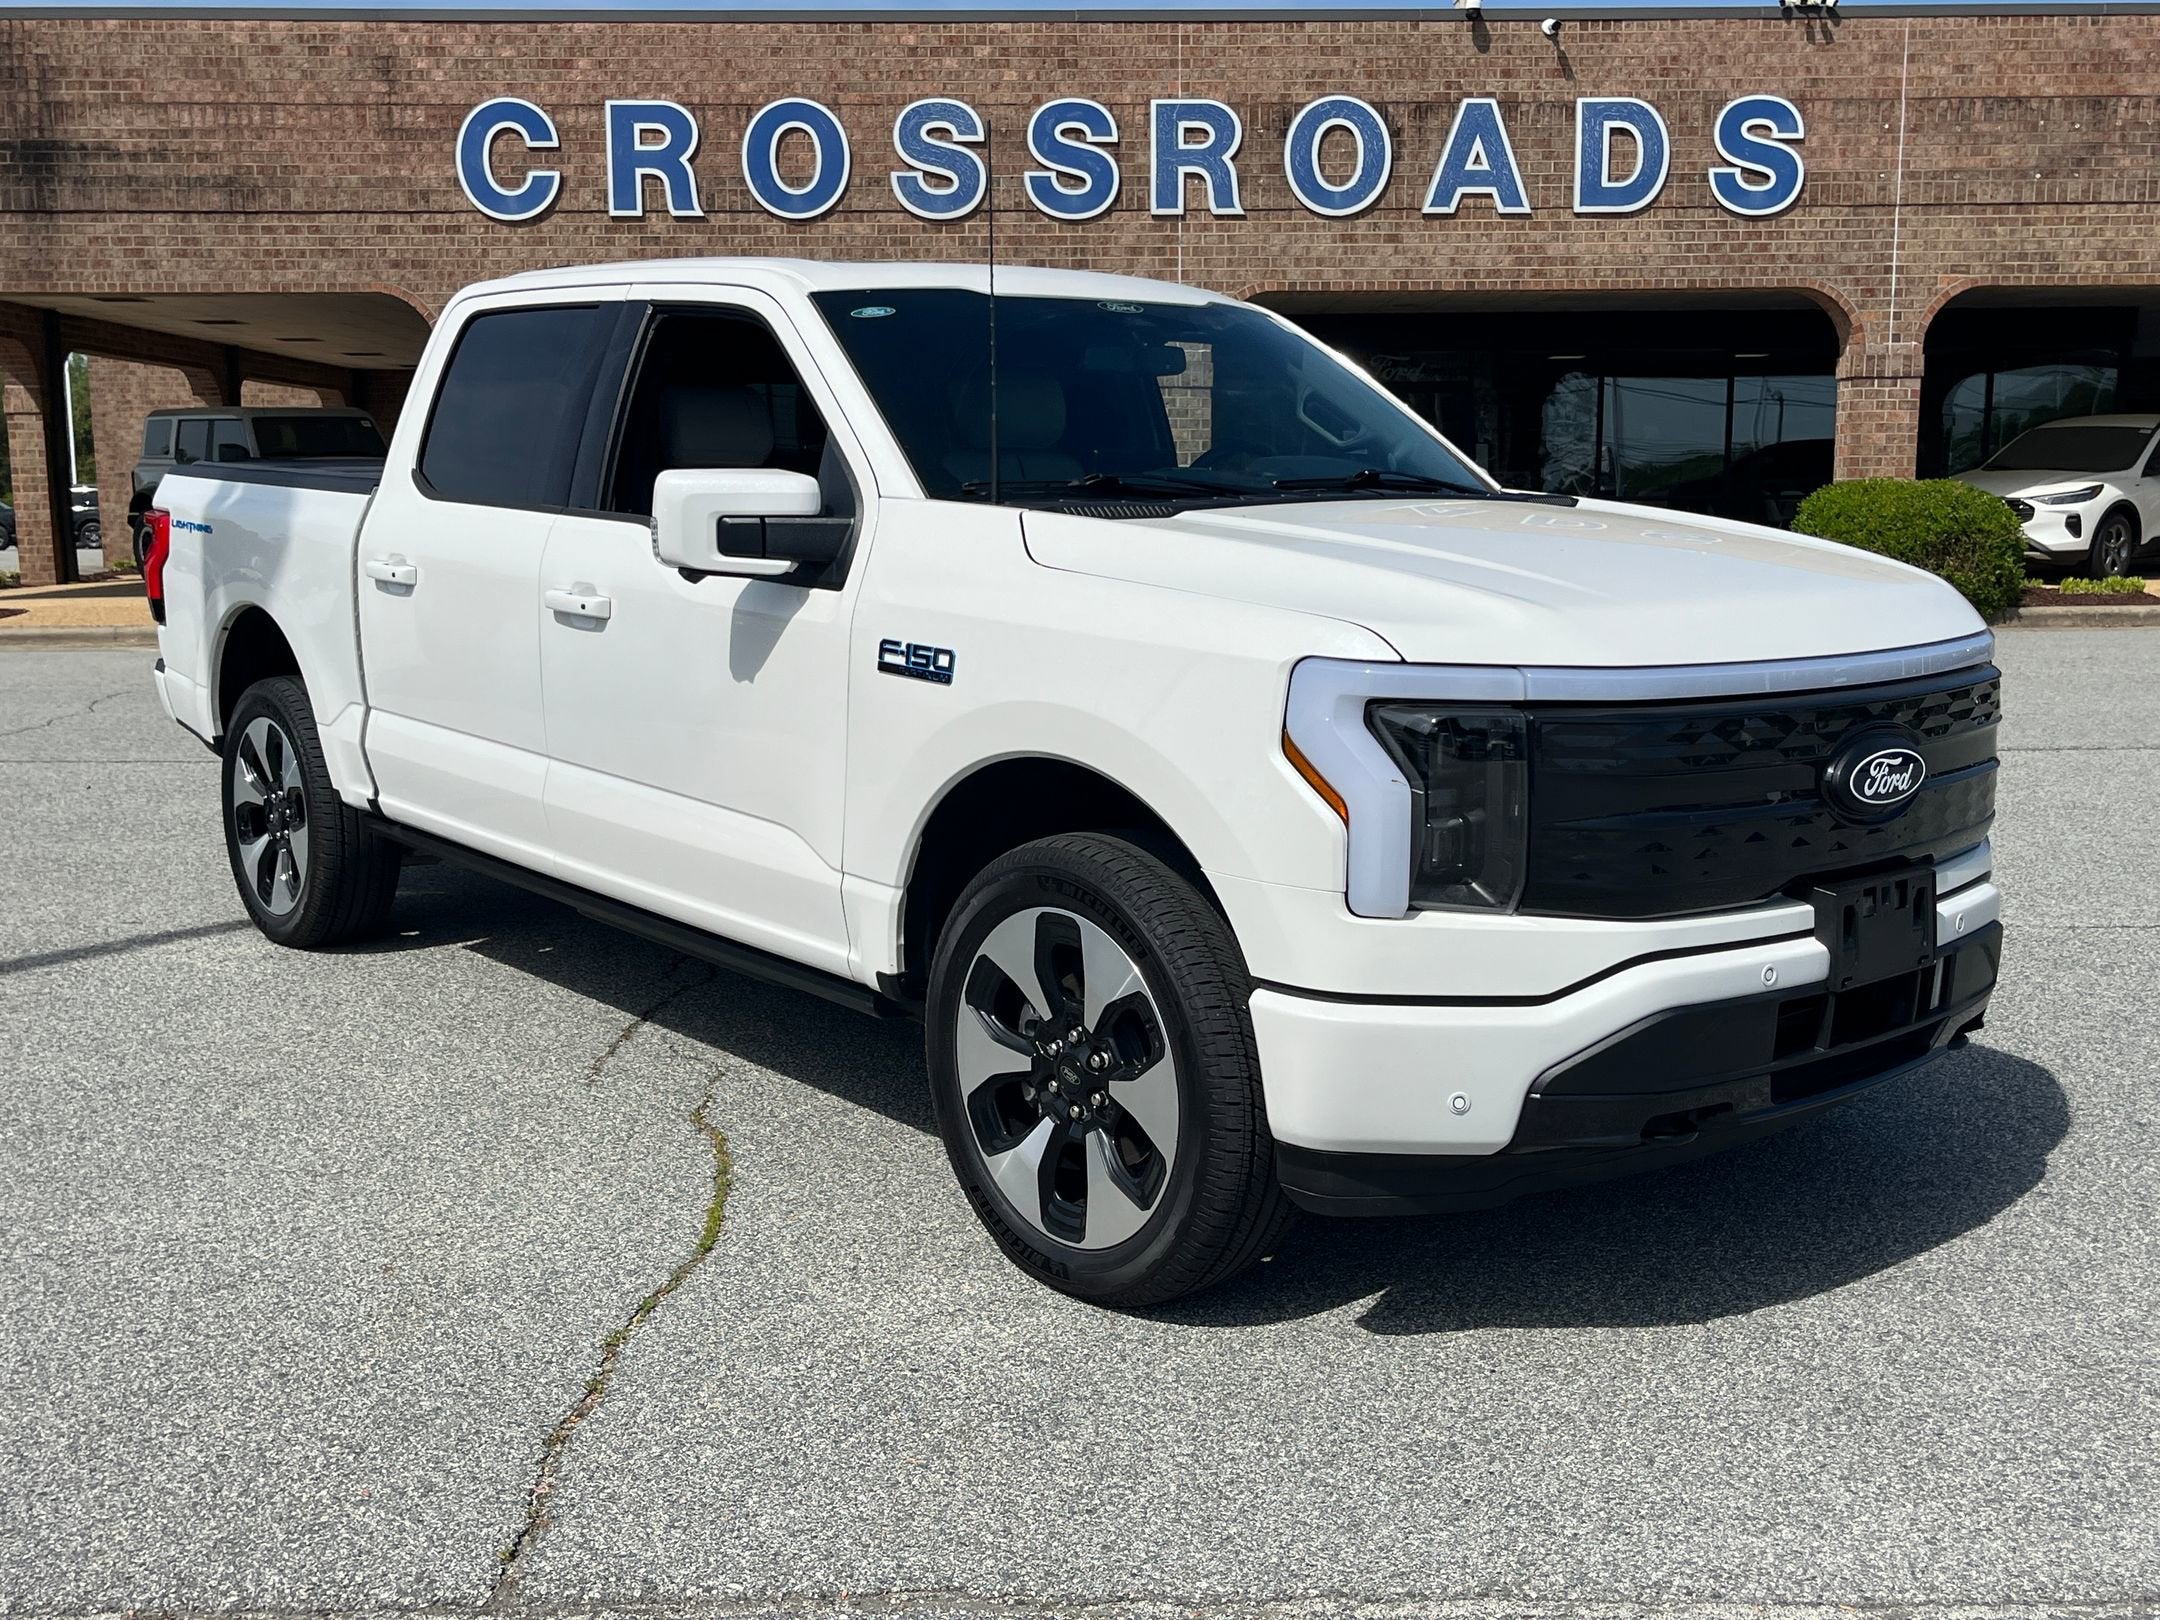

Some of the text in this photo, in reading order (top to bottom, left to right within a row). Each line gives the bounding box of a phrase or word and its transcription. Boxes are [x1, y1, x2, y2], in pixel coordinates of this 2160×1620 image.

[455, 95, 1805, 221] CROSSROADS
[171, 519, 213, 534] LIGHTNING
[878, 638, 956, 672] F-150
[1864, 757, 1914, 796] Ford
[1058, 881, 1148, 958] MICHELIN
